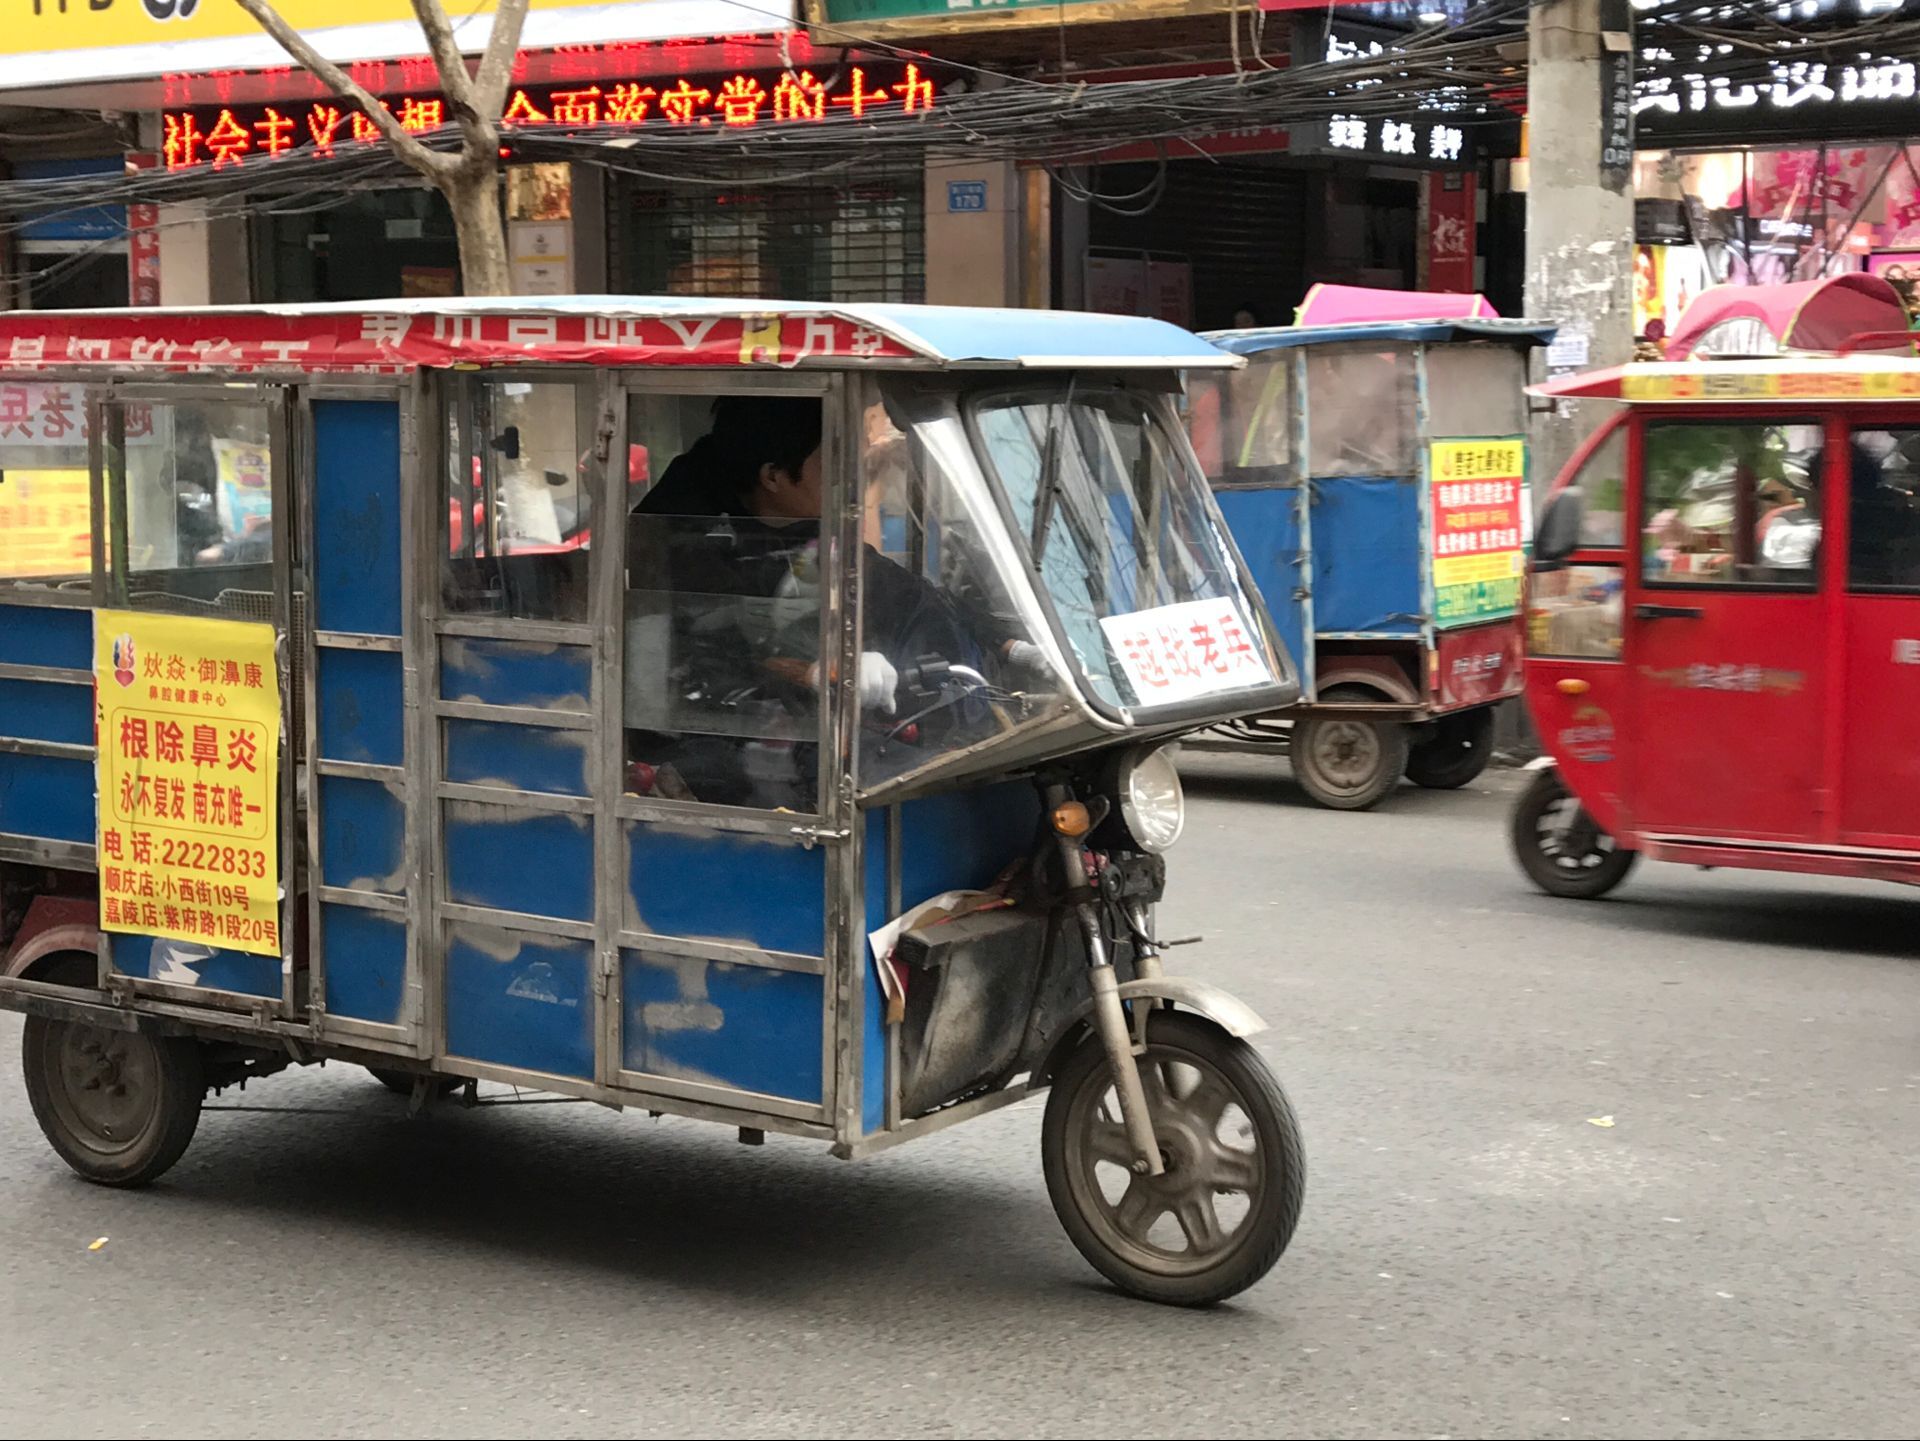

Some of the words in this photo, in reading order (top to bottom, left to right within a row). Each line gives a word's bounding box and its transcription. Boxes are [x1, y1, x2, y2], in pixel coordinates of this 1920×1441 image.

[149, 685, 227, 707] 鼻腔健康中心
[120, 715, 258, 774] 根除鼻炎
[120, 772, 186, 821] 永不复发
[192, 782, 263, 828] 南充唯一
[105, 866, 250, 912] 顺庆店:小西街19号
[105, 896, 278, 947] 嘉陵店:紫府路1段20号
